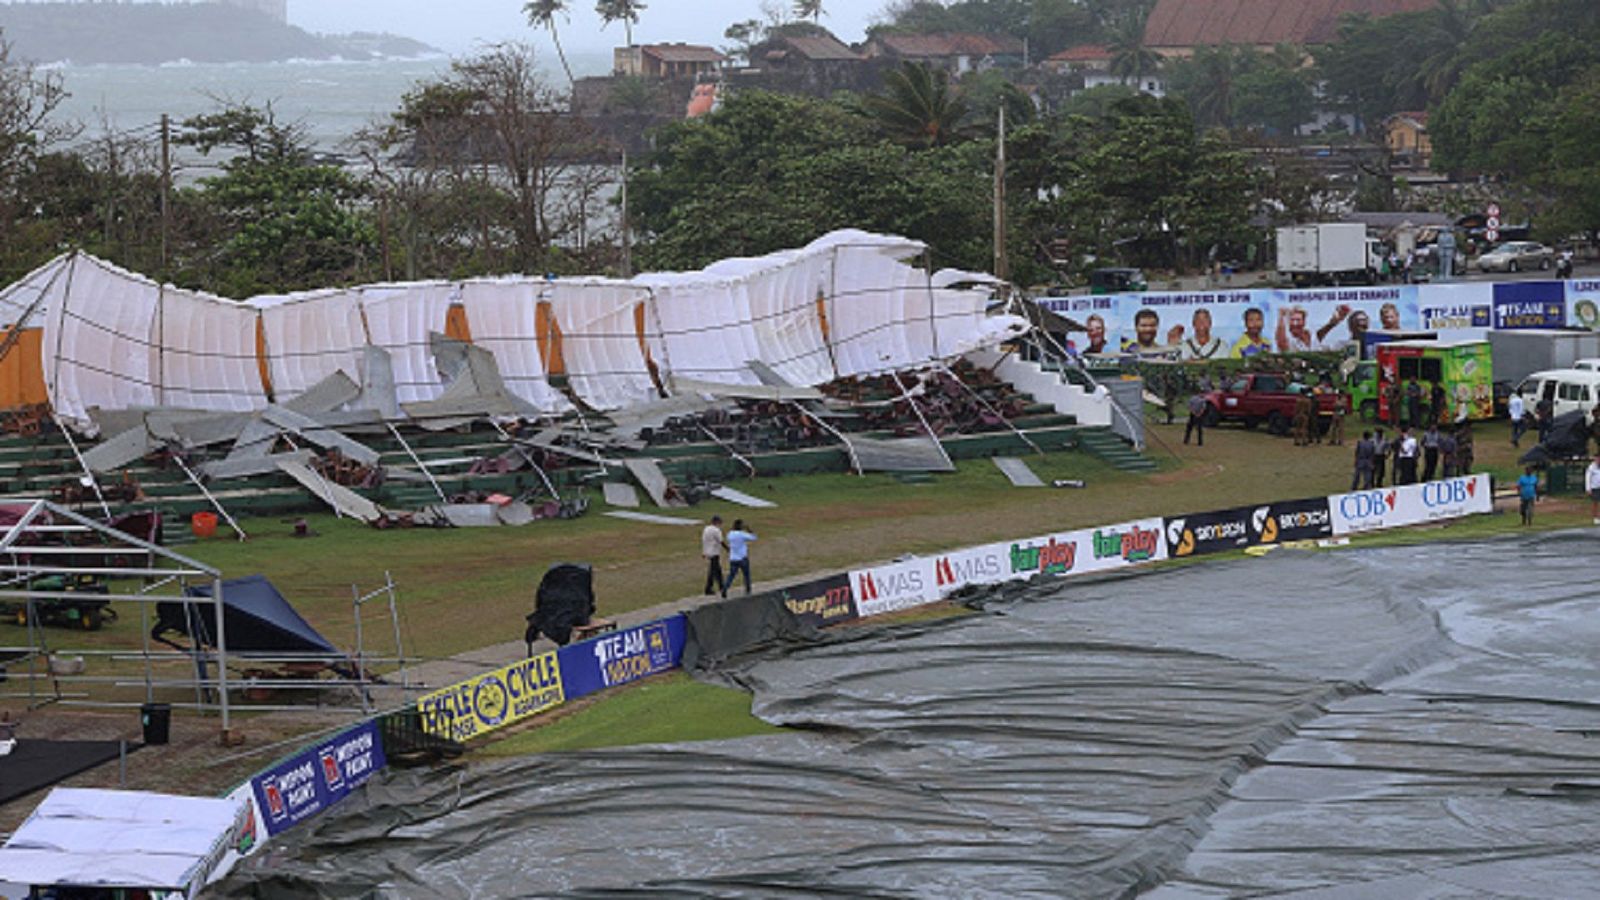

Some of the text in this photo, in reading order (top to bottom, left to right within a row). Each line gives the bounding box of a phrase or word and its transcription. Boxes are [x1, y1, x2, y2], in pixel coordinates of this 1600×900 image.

[1432, 304, 1469, 318] TEAM
[1506, 302, 1544, 316] TEAM
[1340, 490, 1387, 520] CDB
[1422, 480, 1467, 508] CDB
[1010, 537, 1077, 574] fairplay
[1092, 525, 1160, 561] fairplay
[954, 554, 1000, 582] MAS
[877, 569, 924, 599] MAS
[605, 628, 645, 660] TEAM
[506, 655, 558, 699] CYCLE
[607, 652, 652, 683] NATION
